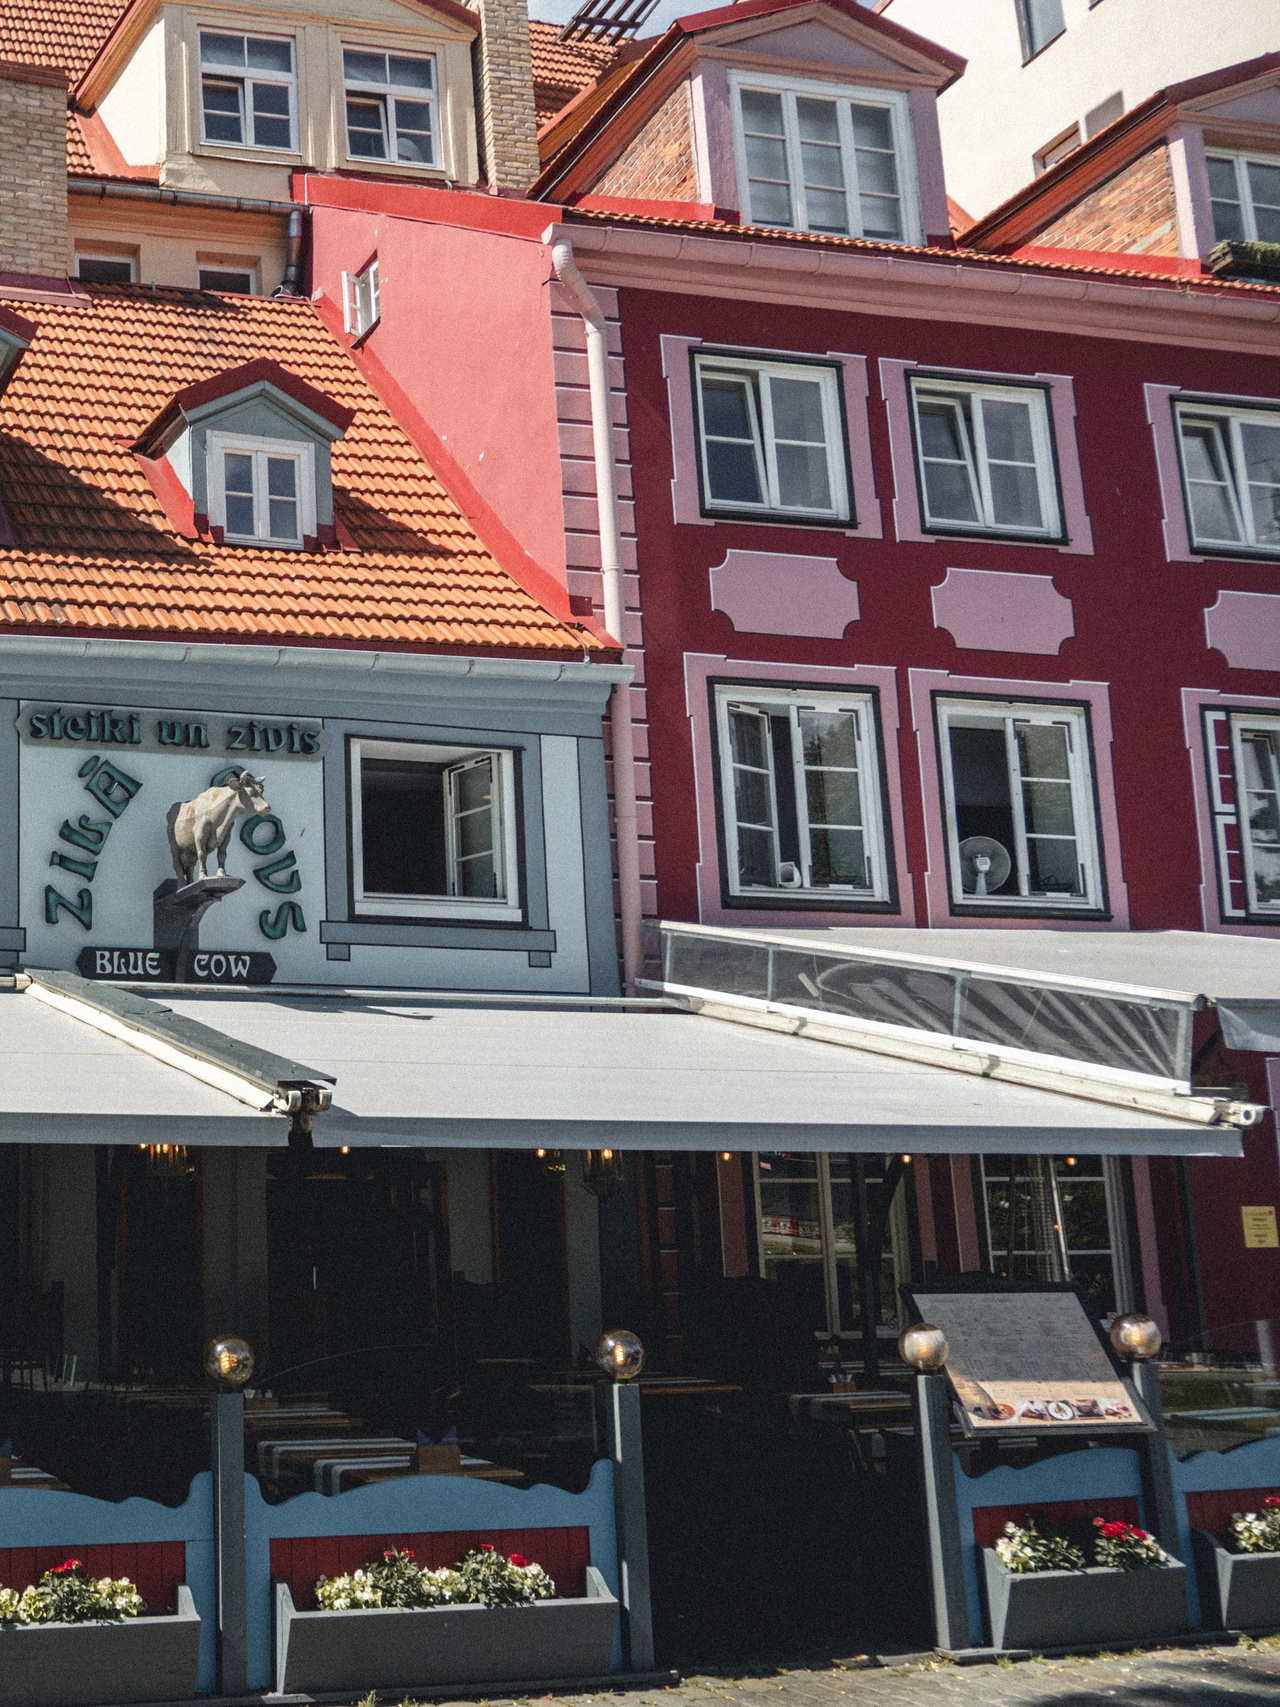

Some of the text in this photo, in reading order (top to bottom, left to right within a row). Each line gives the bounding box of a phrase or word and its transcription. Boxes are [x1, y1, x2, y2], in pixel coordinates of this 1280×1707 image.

[29, 708, 321, 755] steiki un zivis
[95, 950, 251, 978] BLUE COW
